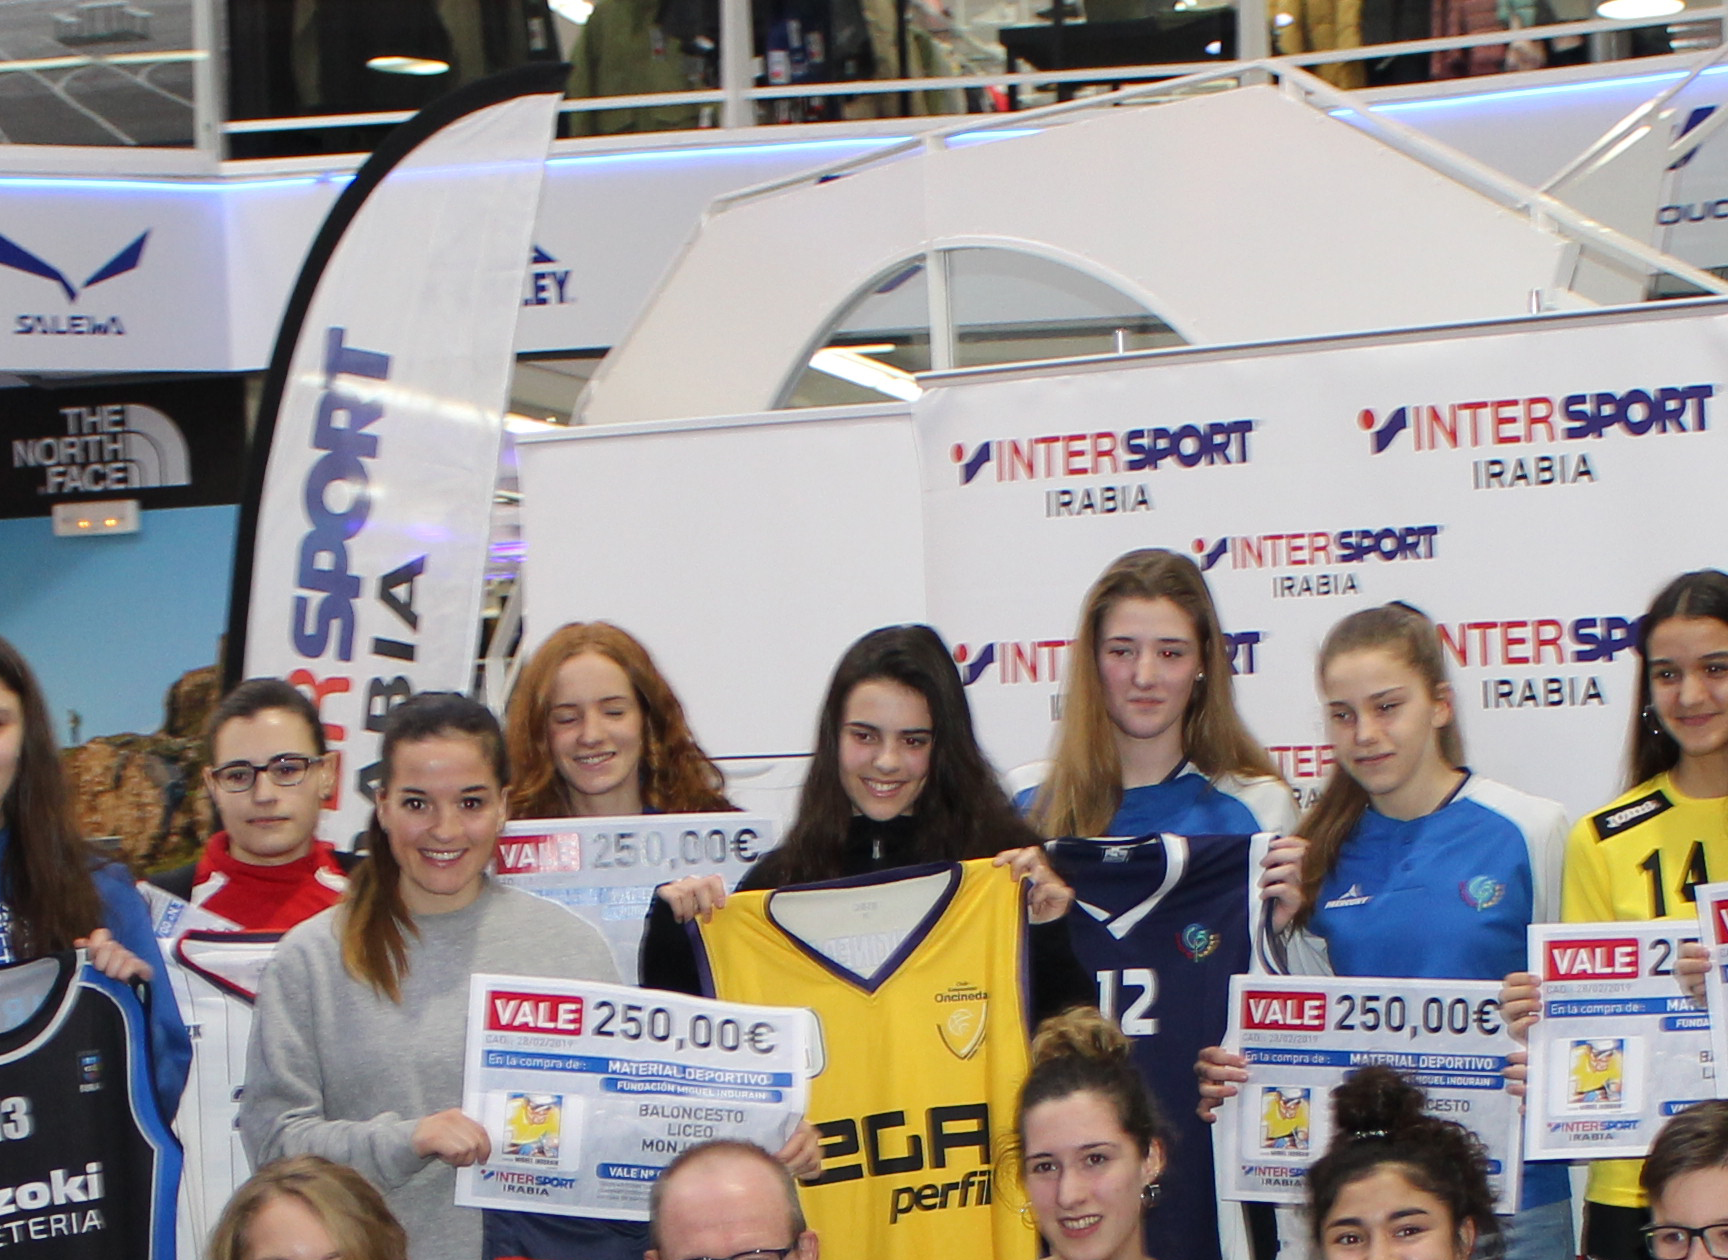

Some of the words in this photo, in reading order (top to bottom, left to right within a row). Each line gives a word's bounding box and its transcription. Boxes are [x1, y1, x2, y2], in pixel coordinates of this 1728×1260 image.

[14, 315, 126, 336] SALEWA
[61, 406, 123, 434] THE
[1413, 384, 1716, 450] INTERSPORT
[12, 435, 126, 469] NORTH
[995, 419, 1255, 483] INTERSPORT
[43, 462, 129, 494] FACE
[1473, 454, 1595, 490] IRABIA
[1045, 484, 1151, 517] IRABIA
[1231, 526, 1438, 570] INTERSPORT
[1272, 573, 1358, 598] IRABIA
[1482, 677, 1604, 709] IRABIA
[1551, 944, 1637, 974] VALE
[1098, 968, 1160, 1035] 12
[1248, 999, 1322, 1026] VALE
[1334, 994, 1501, 1040] 250,00€
[494, 998, 580, 1030] VALE
[591, 1000, 774, 1054] 250,00€
[608, 1060, 682, 1077] MATERIAL
[685, 1068, 768, 1085] DEPORTIVO
[639, 1105, 744, 1122] BALONCESTO
[1561, 1119, 1640, 1131] INTERSPORT
[667, 1124, 714, 1138] LICEO
[495, 1170, 576, 1189] INTERSPORT
[503, 1184, 549, 1196] IRABIA
